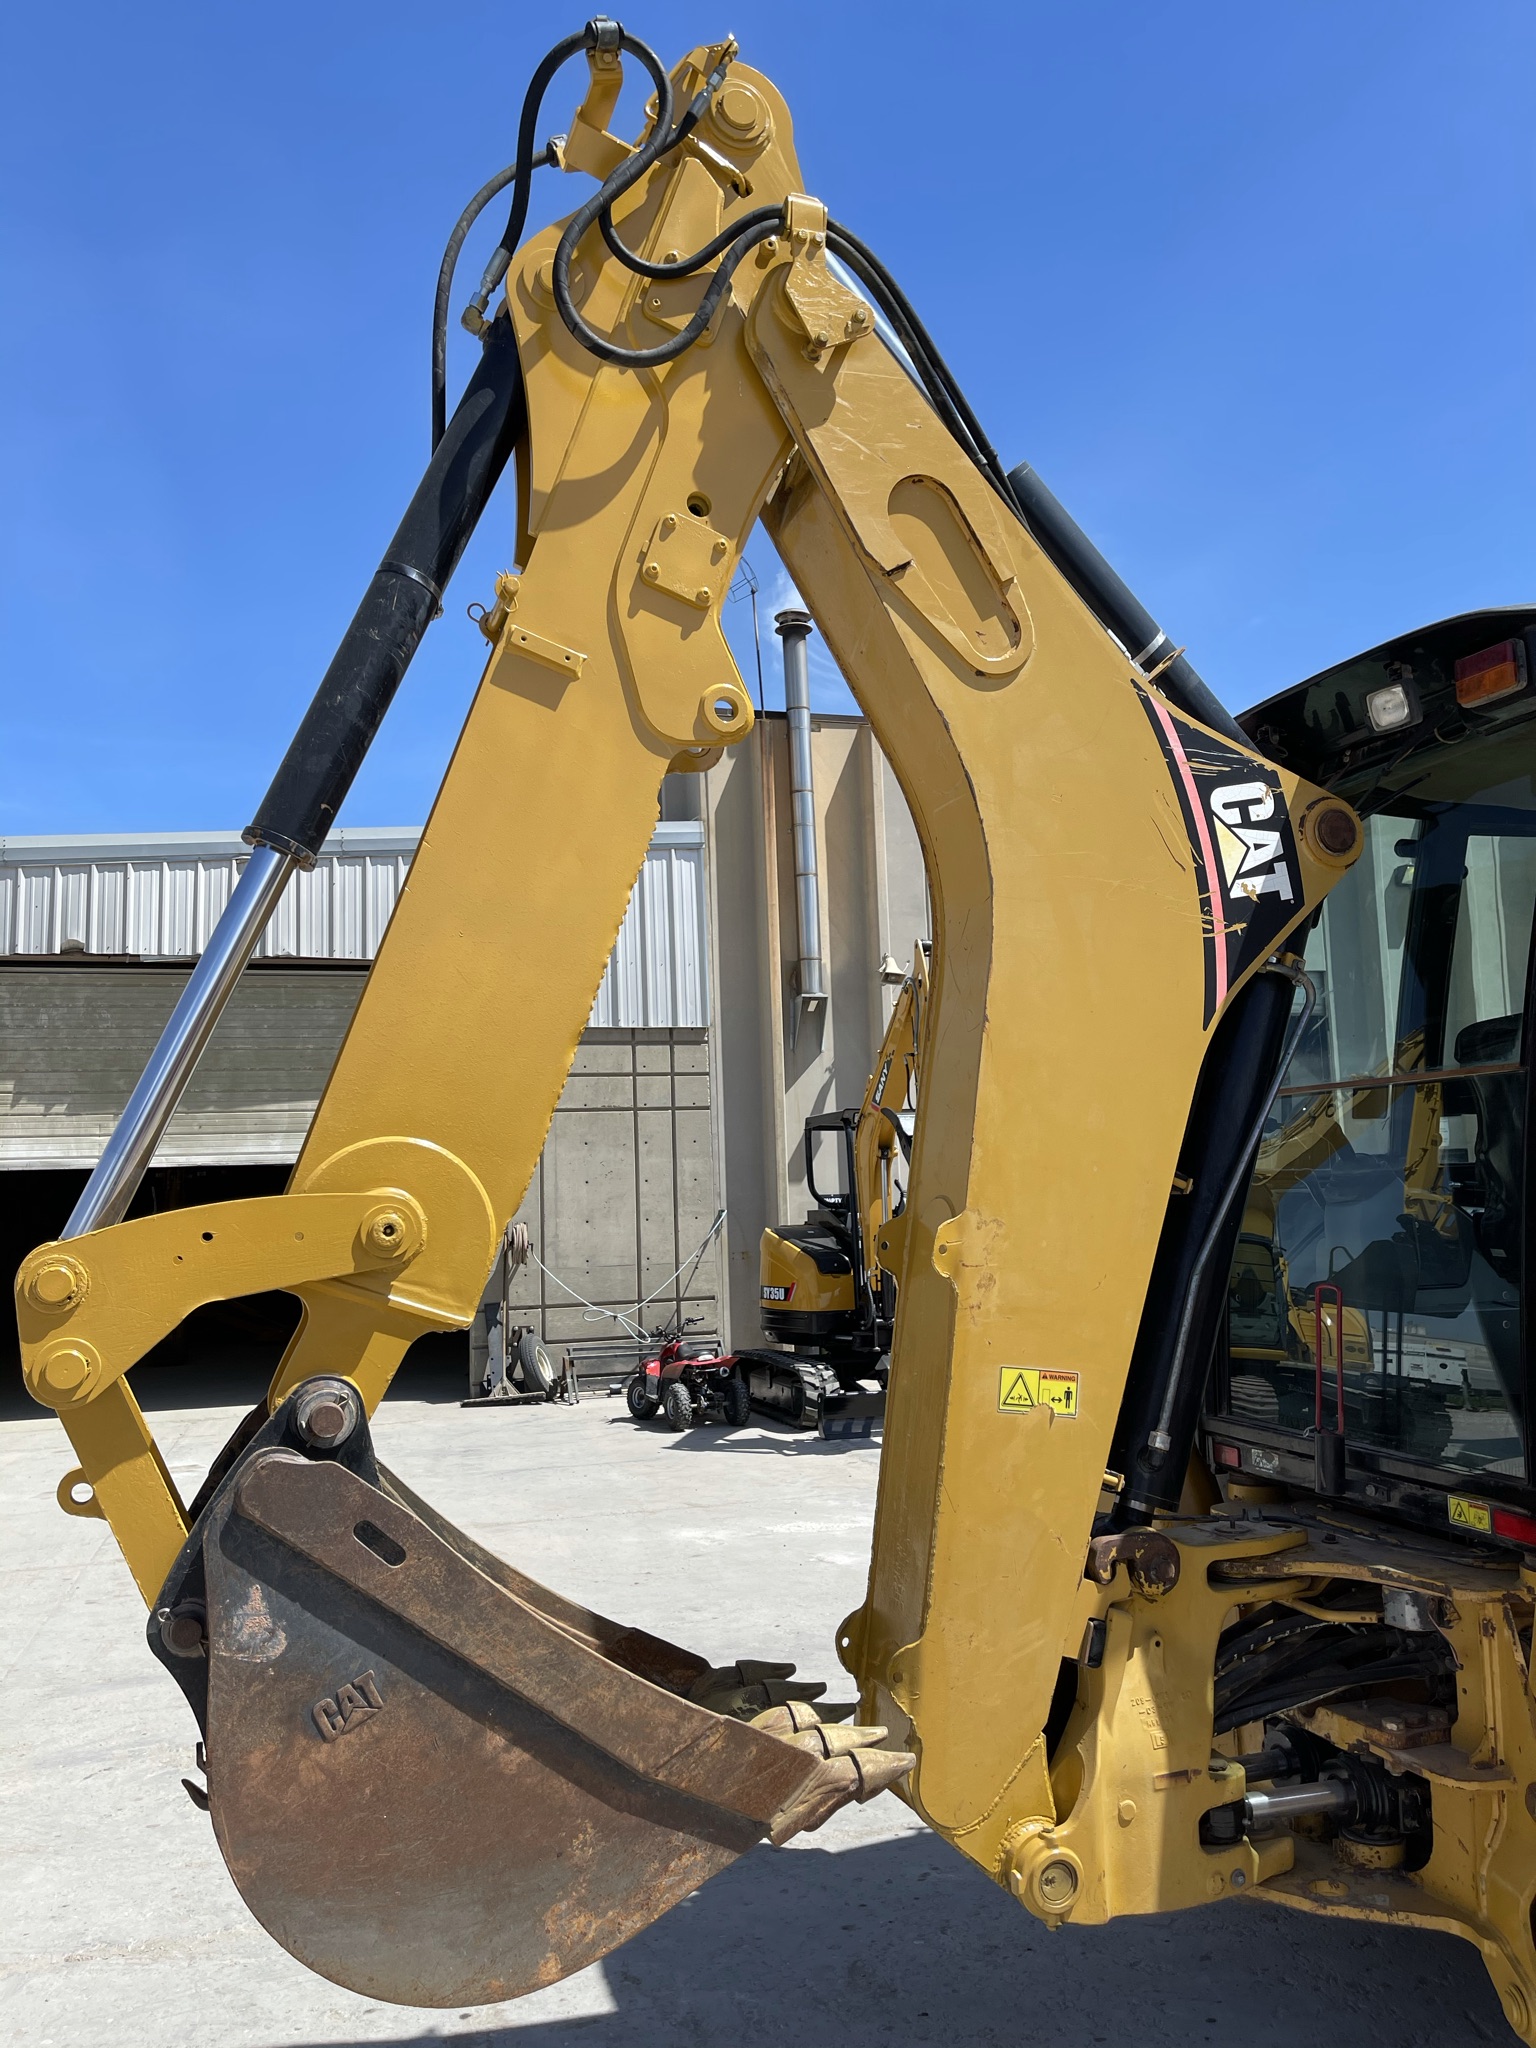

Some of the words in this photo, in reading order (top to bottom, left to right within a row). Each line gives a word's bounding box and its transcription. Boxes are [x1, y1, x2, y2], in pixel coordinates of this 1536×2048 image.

[1210, 781, 1294, 899] CAT
[875, 1063, 888, 1104] SANY
[1048, 1373, 1076, 1382] WARNING
[312, 1669, 384, 1744] CAT
